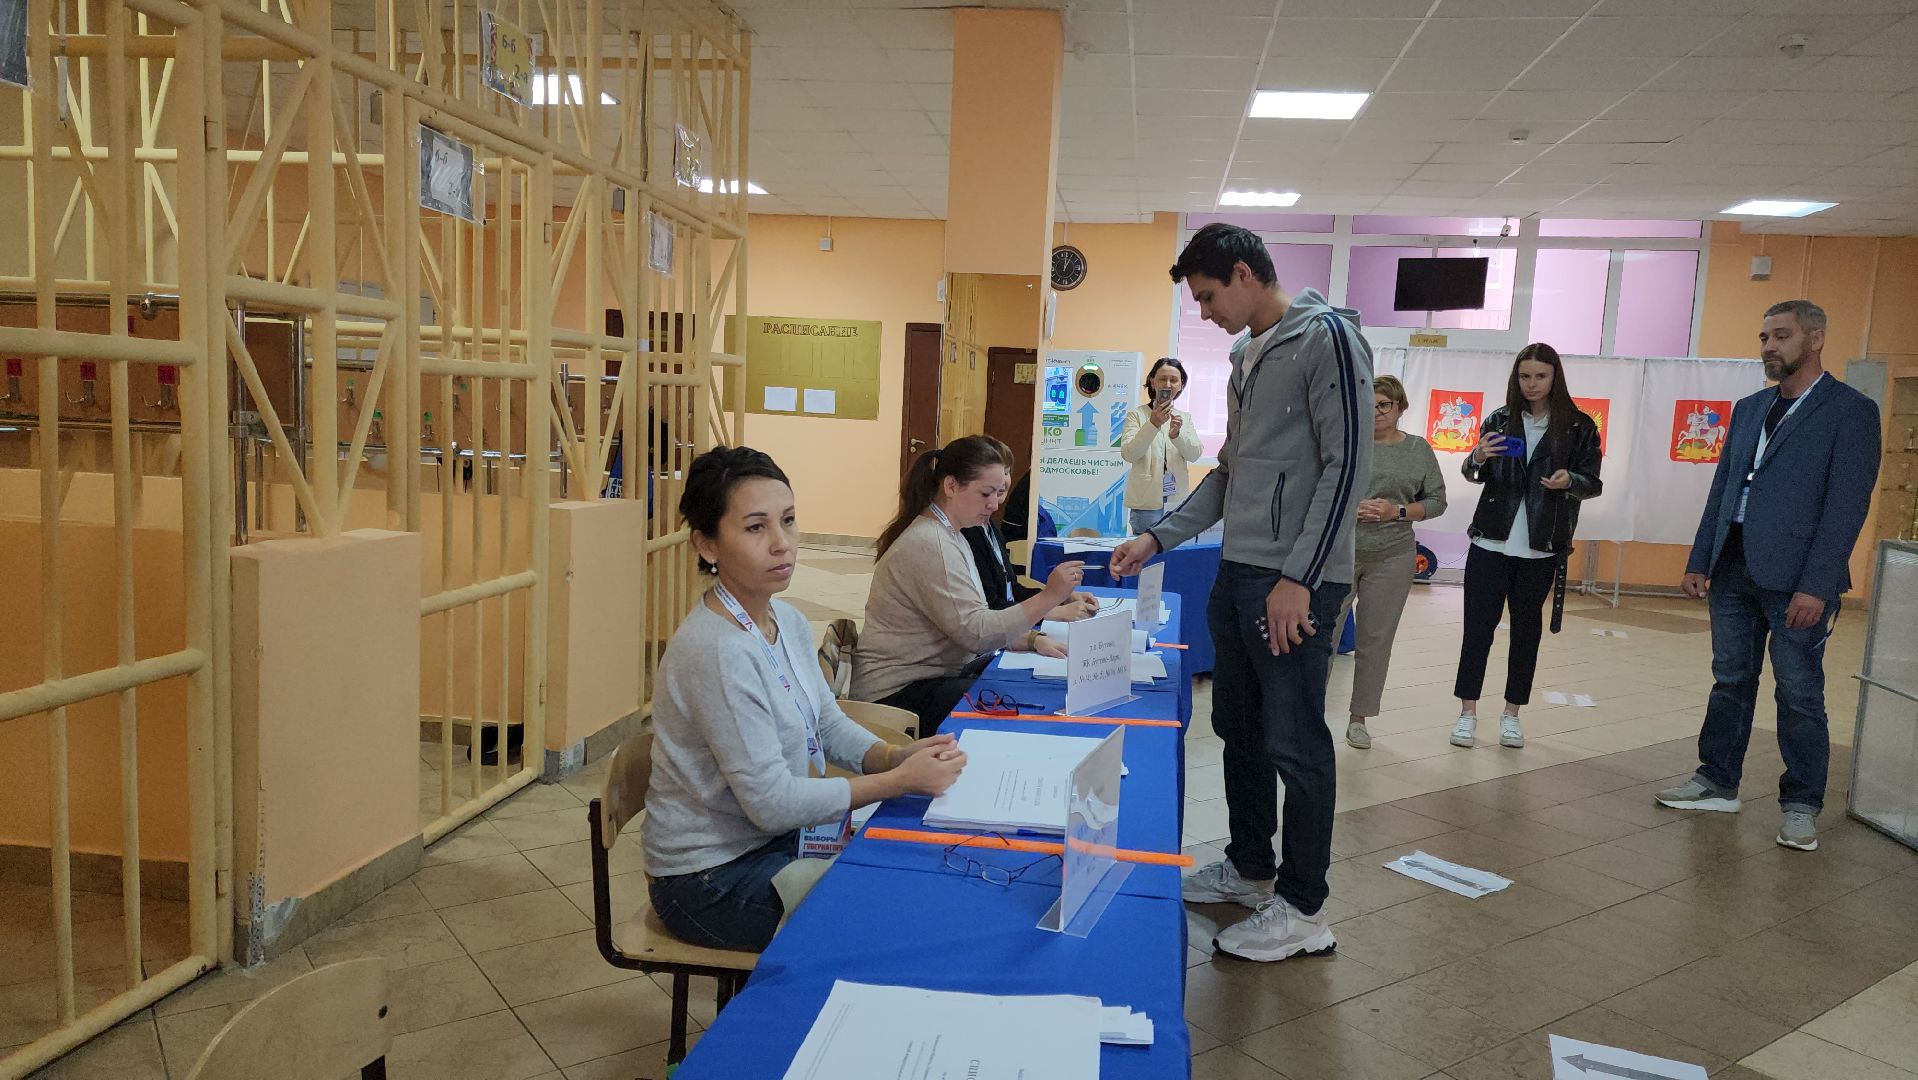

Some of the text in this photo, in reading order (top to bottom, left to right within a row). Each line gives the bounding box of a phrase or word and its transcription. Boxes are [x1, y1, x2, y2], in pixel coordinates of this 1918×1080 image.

[762, 322, 859, 338] РАСПИСАНИЕ
[1046, 457, 1087, 466] ДЕЛАЕШЬ
[1088, 459, 1124, 468] ЧИСТЫМ
